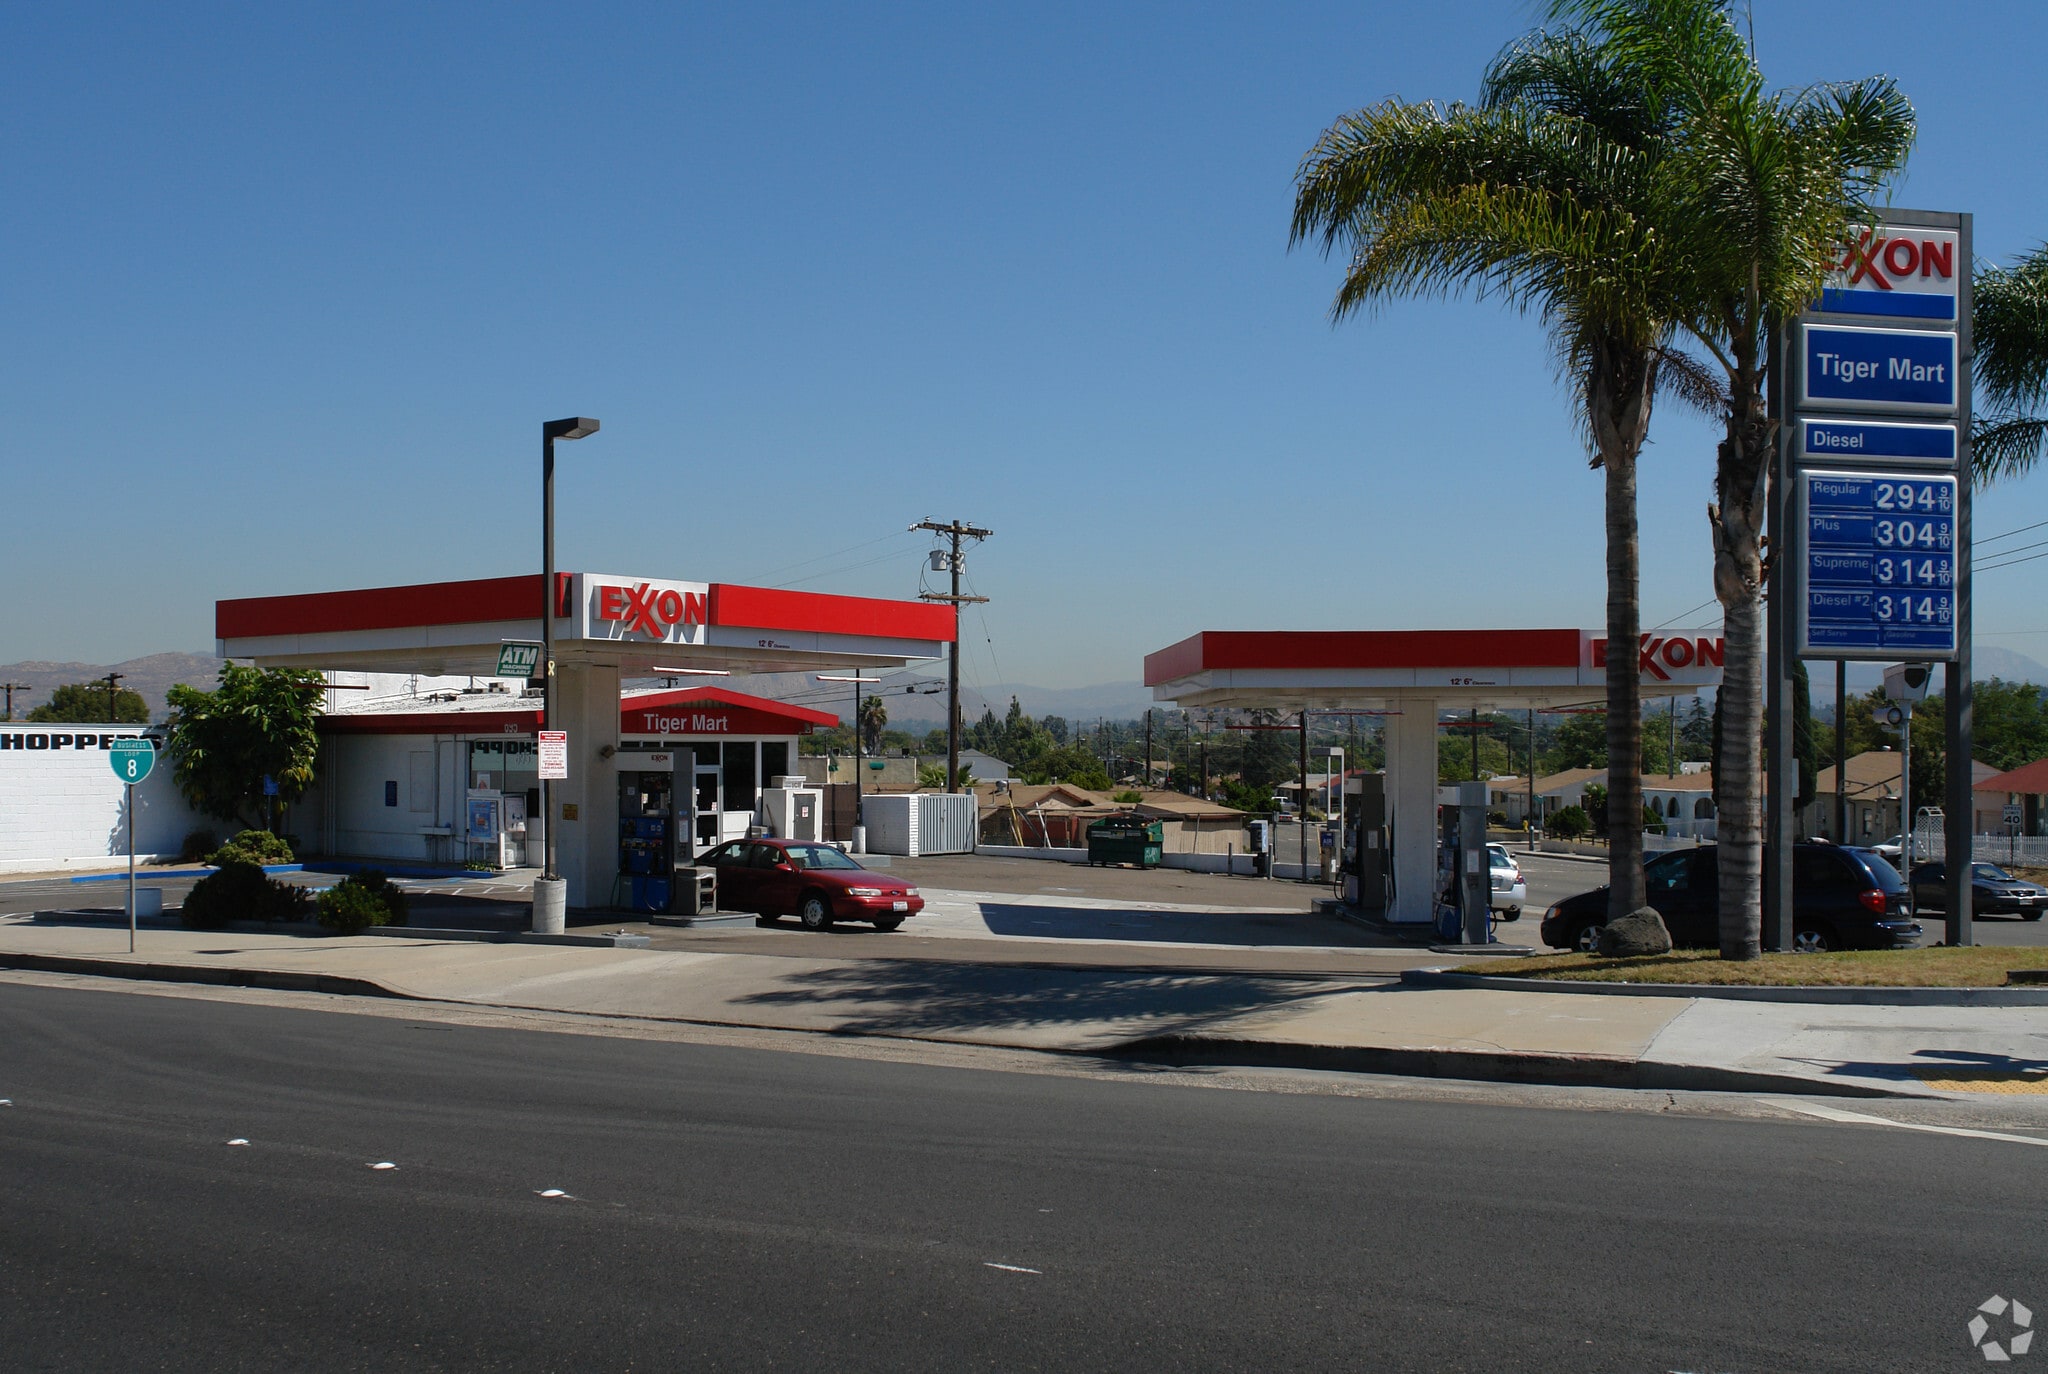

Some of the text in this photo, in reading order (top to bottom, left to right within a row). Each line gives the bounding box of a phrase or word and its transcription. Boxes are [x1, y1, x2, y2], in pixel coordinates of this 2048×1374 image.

[1822, 231, 1953, 290] XXON
[1817, 353, 1945, 383] Tiger Mart
[1813, 430, 1863, 448] Diesel
[1814, 481, 1861, 497] Regular
[1877, 484, 1936, 509] 294
[1813, 518, 1840, 531] Plus
[1877, 521, 1936, 546] 304
[1813, 555, 1869, 571] Supreme
[1878, 558, 1936, 583] 314
[601, 583, 707, 638] EXXON
[1813, 593, 1852, 606] Diesel
[1854, 594, 1871, 607] #2
[1877, 595, 1935, 620] 314
[500, 646, 538, 665] ATM
[1591, 633, 1724, 680] EXON
[643, 713, 728, 734] Tiger Mart
[127, 759, 137, 777] 8
[651, 754, 669, 763] EXXON
[2004, 815, 2020, 824] 40
